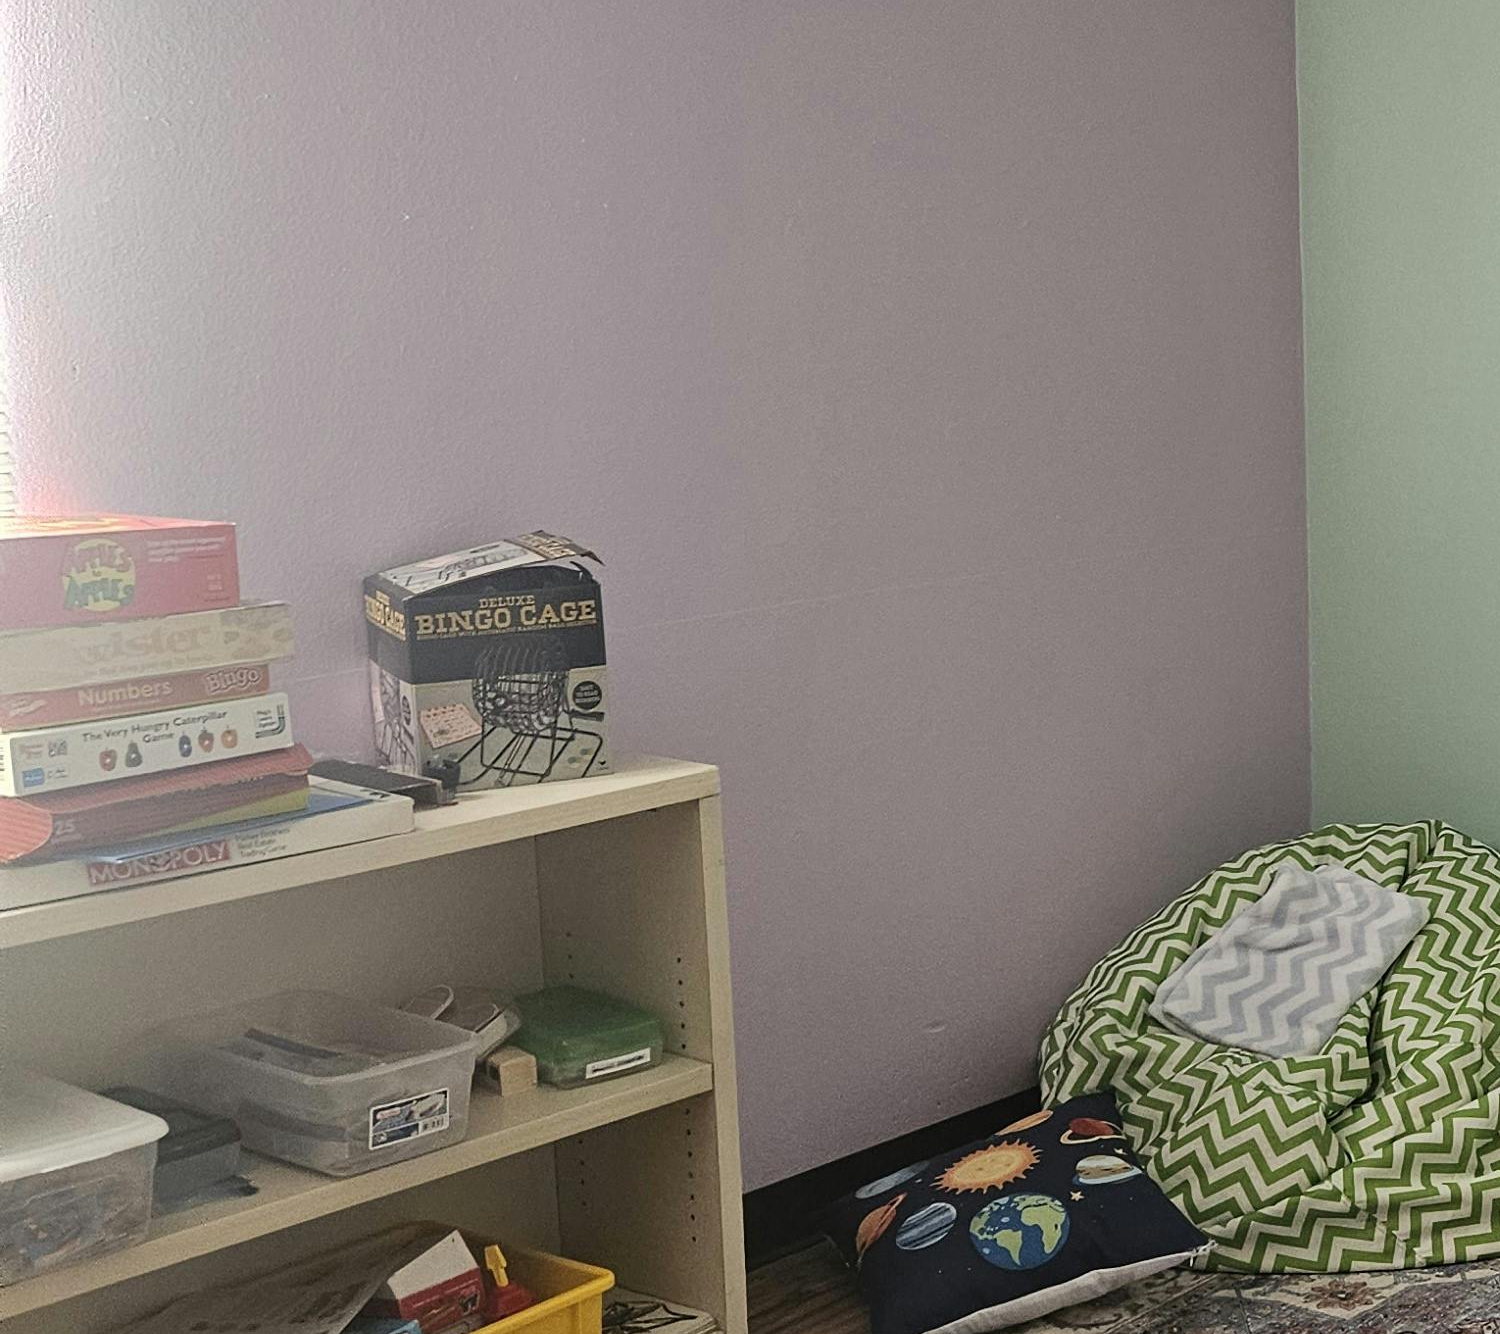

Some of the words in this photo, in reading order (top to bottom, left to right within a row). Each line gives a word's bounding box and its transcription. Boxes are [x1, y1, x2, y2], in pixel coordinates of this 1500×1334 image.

[479, 594, 535, 609] DELUXE
[416, 609, 510, 636] BINGO
[520, 599, 597, 626] CAGE
[78, 680, 173, 707] Numbers
[206, 667, 261, 696] Bingo
[82, 731, 102, 743] The
[103, 727, 129, 742] Very
[131, 720, 170, 737] Hungry
[173, 709, 228, 727] Caterpillar
[142, 731, 175, 744] Game
